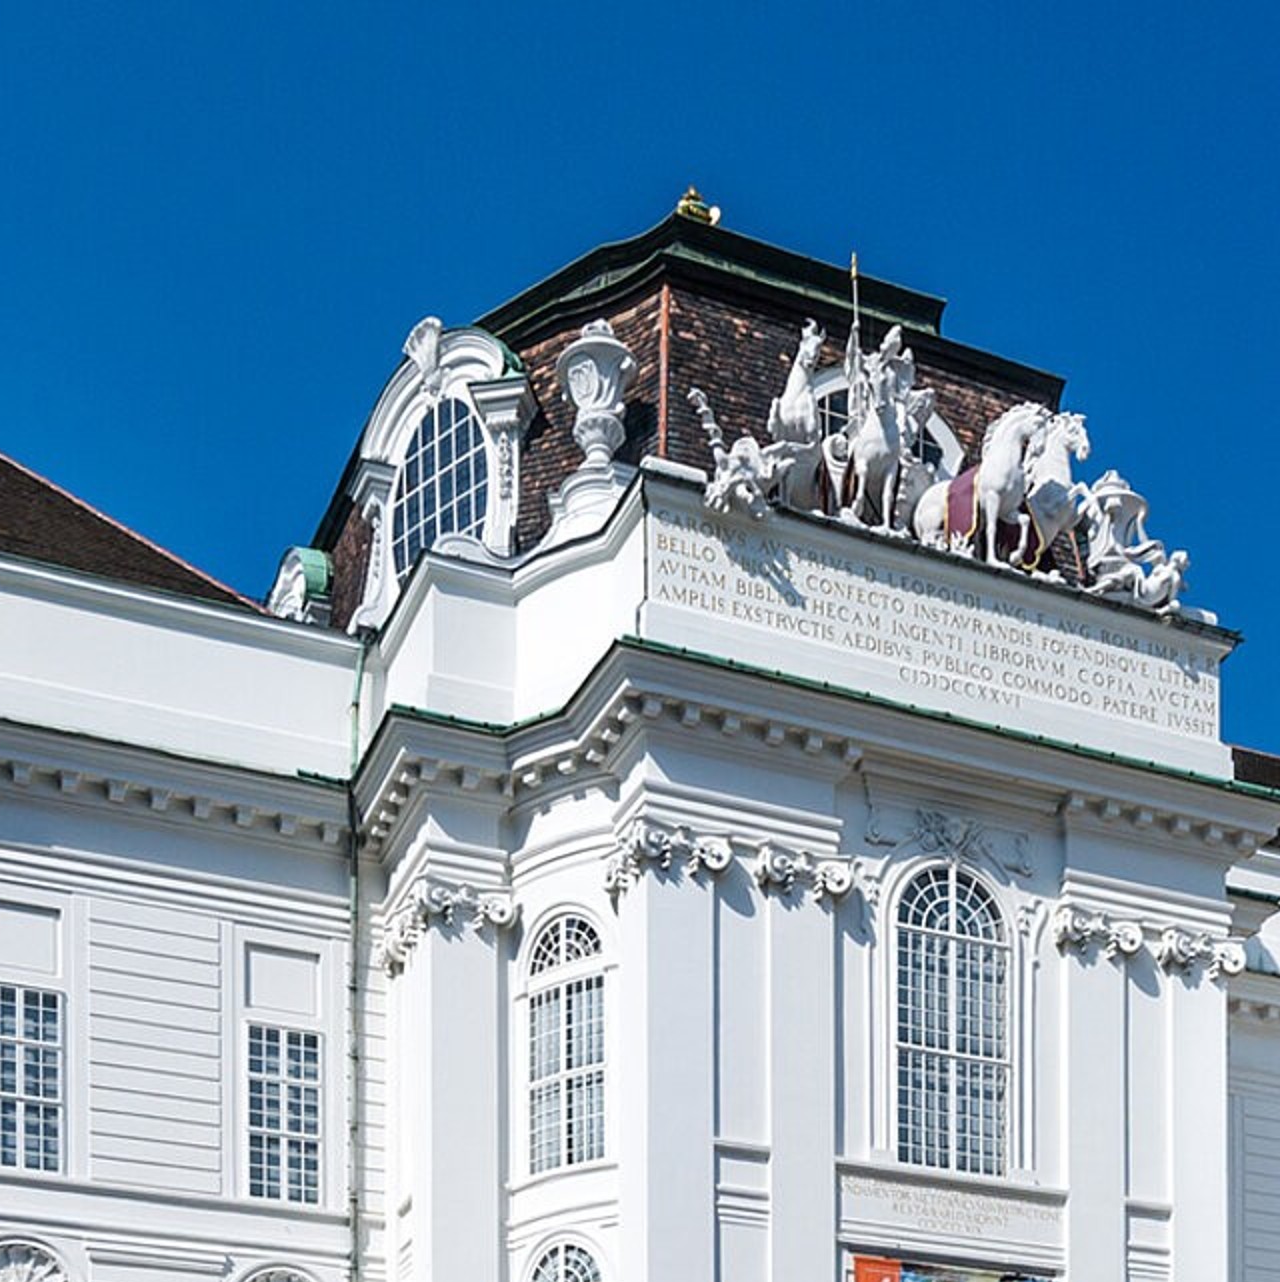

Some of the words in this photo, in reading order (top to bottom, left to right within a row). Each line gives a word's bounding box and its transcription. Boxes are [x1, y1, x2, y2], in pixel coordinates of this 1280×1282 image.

[657, 533, 717, 563] BELLO
[805, 574, 905, 614] CONFECTO
[914, 603, 1033, 647] INSTAVRANDIS
[1042, 637, 1149, 677] FOVENDISQVE
[657, 559, 726, 590] AVITAM
[736, 578, 881, 630] BIBLIOTHECAM
[892, 619, 963, 652] INGENTI
[972, 640, 1065, 677] LIBRORVM
[1077, 668, 1135, 696] COPIA
[1147, 686, 1216, 717] AVCTAM
[657, 583, 725, 614] AMPLIS
[732, 600, 835, 641] EXSTRVCTIS
[842, 632, 913, 661] AEDIBVS
[923, 650, 994, 682] PVBLICO
[1002, 670, 1092, 706] COMMODO
[1103, 695, 1158, 723] PATERE
[1167, 712, 1215, 737] IVSSIT
[888, 571, 981, 609] LEOPOLDI
[1059, 619, 1090, 638] AVG
[1101, 628, 1139, 651] ROM
